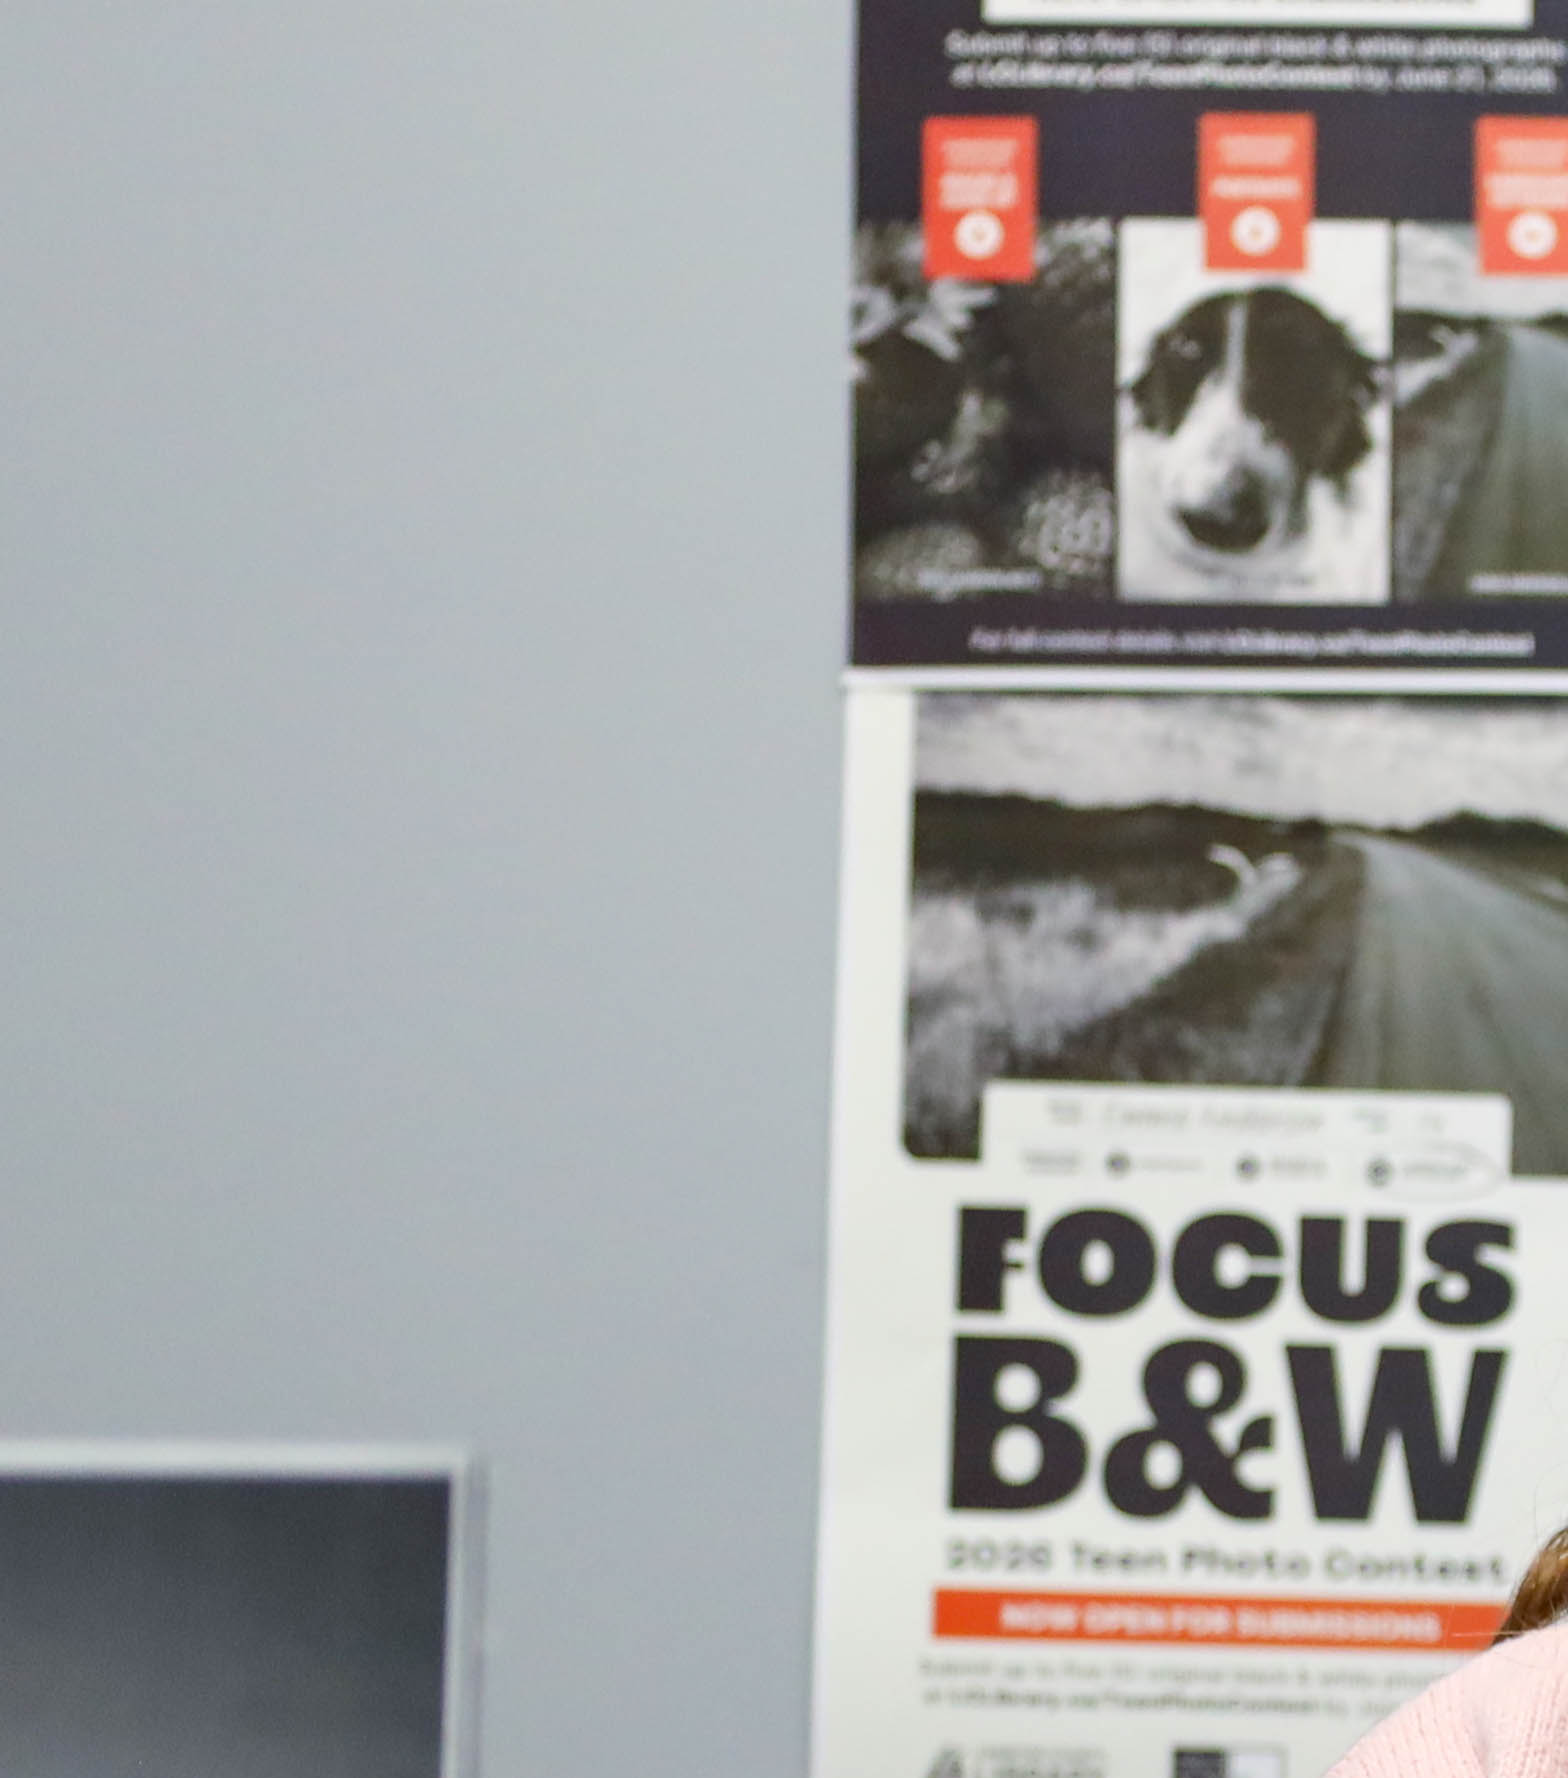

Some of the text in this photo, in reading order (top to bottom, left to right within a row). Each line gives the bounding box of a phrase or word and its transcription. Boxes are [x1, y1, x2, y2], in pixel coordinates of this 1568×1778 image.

[957, 1207, 1517, 1328] FOCUS
[946, 1334, 1510, 1525] B&W
[949, 1541, 1503, 1581] 2026 Teen Photo Contest
[1000, 1602, 1440, 1642] NOW OPEN FOR SUBMISSIONS
